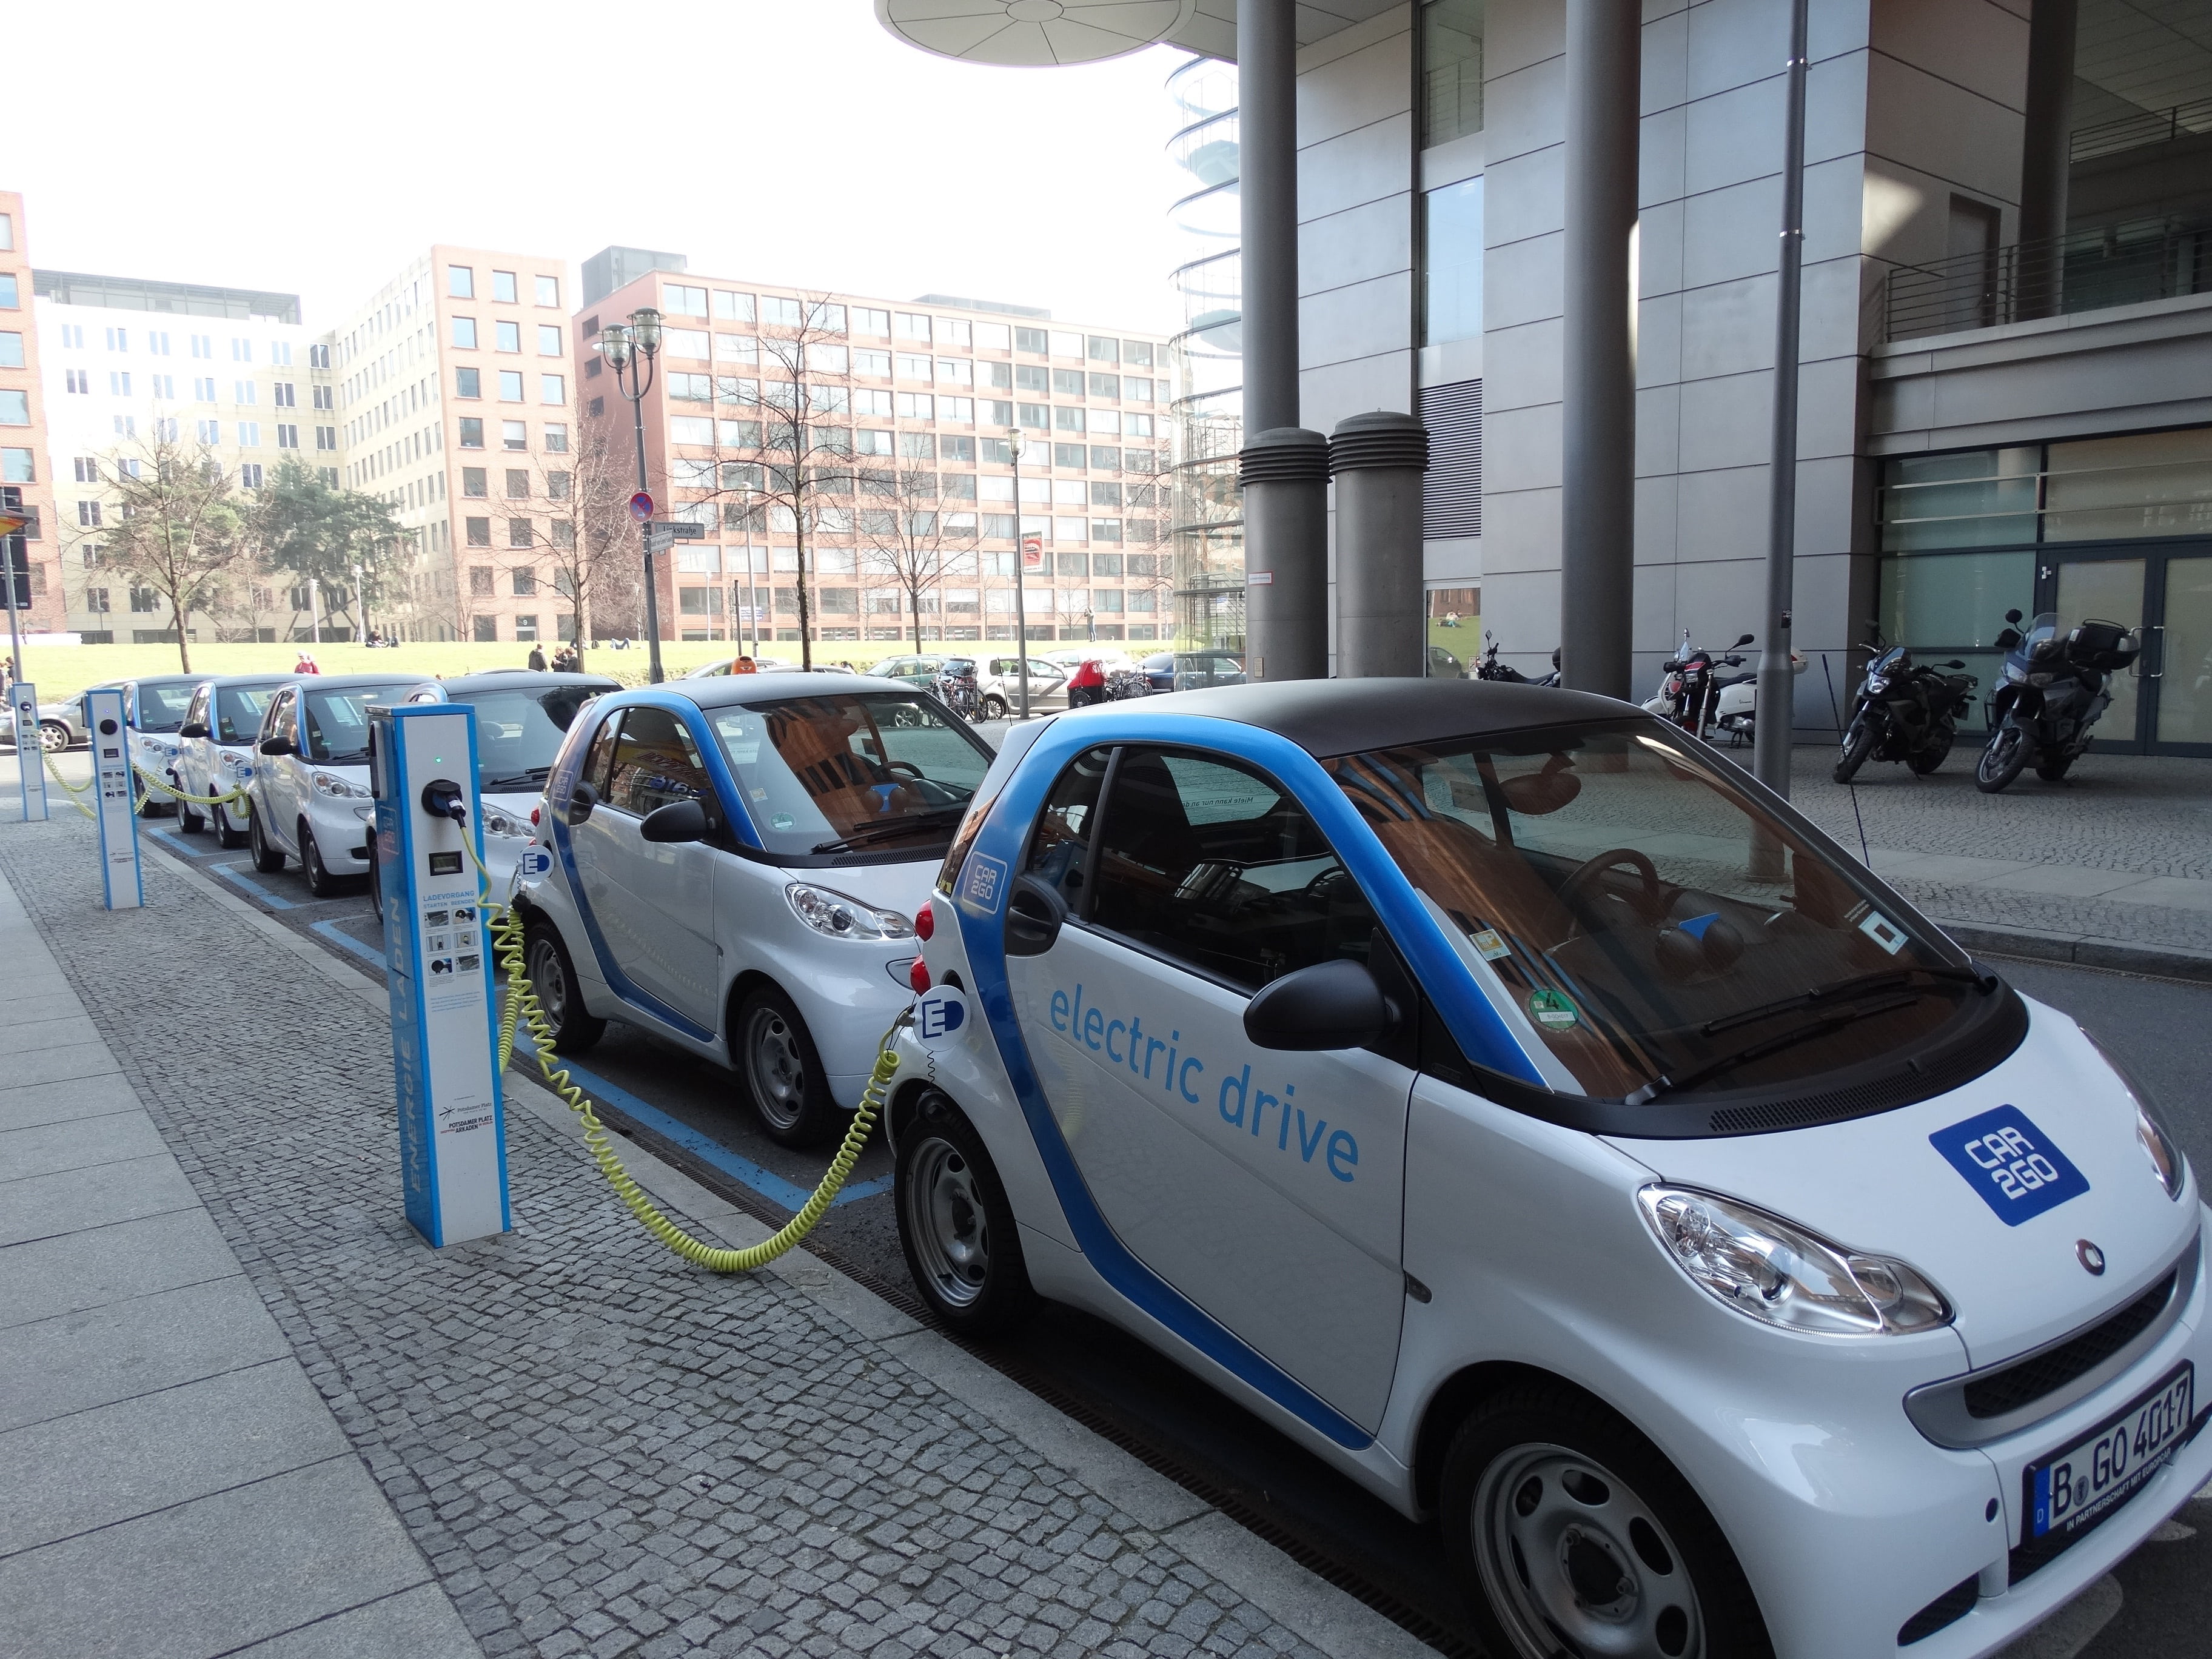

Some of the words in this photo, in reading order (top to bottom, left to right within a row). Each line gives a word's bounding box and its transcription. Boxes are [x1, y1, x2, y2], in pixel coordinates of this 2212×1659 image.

[663, 526, 697, 535] Likstraße
[975, 865, 997, 885] CAR
[423, 890, 475, 902] LADEVORGANG
[971, 879, 993, 900] 2GO
[390, 897, 407, 1022] LADEN
[1546, 992, 1560, 1010] 4
[1051, 983, 1204, 1104] electric
[1219, 1064, 1358, 1182] drive
[401, 1037, 420, 1193] ENERGIE
[449, 1118, 478, 1128] POTSDAMER
[455, 1124, 478, 1133] ARKADEN
[1965, 1126, 2034, 1168] CAR
[1991, 1153, 2058, 1199] 2GO
[2053, 1462, 2071, 1518] B
[2093, 1426, 2127, 1491] GO
[2133, 1375, 2188, 1458] 4017
[2066, 1519, 2074, 1531] IN
[2076, 1481, 2130, 1526] PARTNERSCHAFT
[2130, 1472, 2141, 1487] MIT
[2037, 1509, 2044, 1524] D
